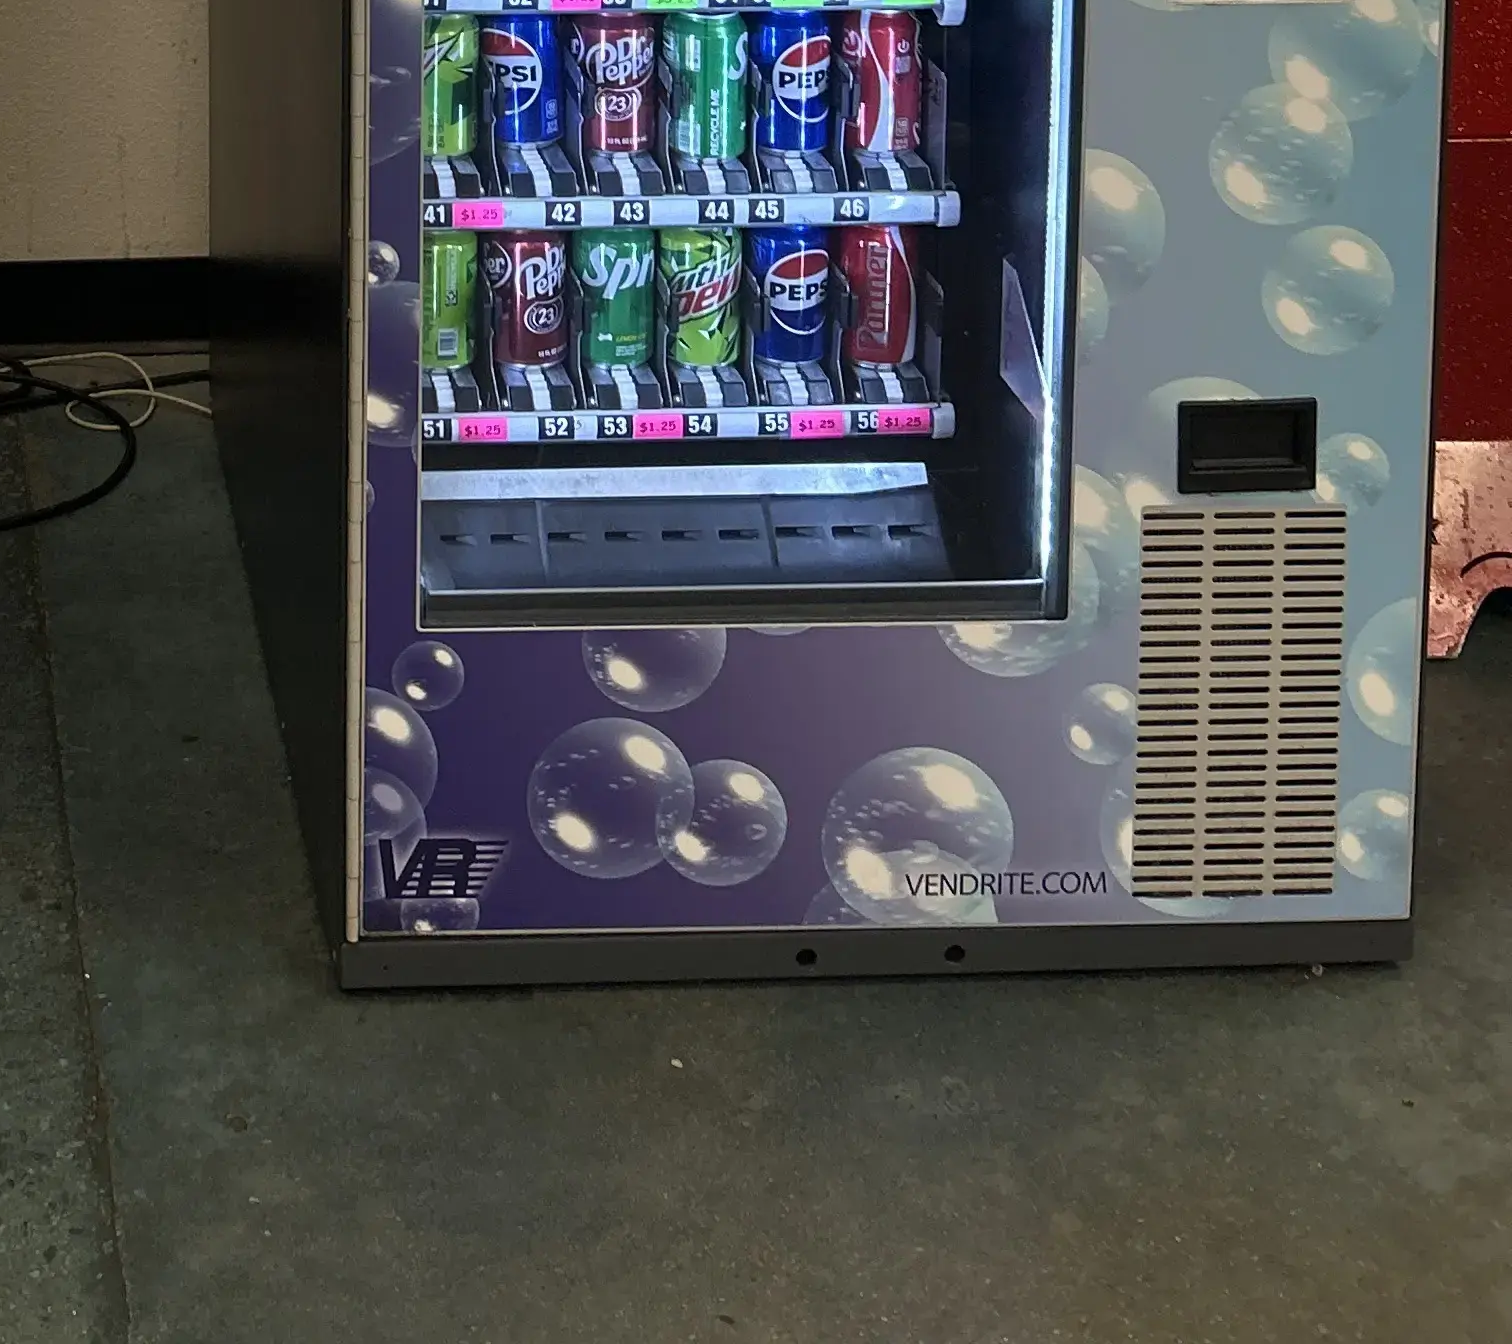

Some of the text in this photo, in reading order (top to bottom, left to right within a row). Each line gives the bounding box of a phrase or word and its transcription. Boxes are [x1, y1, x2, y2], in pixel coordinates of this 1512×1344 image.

[607, 95, 627, 111] 23
[424, 205, 445, 223] 41
[552, 204, 575, 222] 42
[620, 203, 644, 221] 43
[705, 202, 729, 220] 44
[755, 200, 779, 218] 45
[840, 199, 864, 217] 46
[424, 419, 445, 438] 51
[545, 418, 568, 436] 52
[604, 417, 627, 435] 53
[688, 414, 712, 433] 54
[765, 413, 788, 431] 55
[858, 411, 878, 429] 56
[905, 871, 1107, 897] VENDRITE.COM
